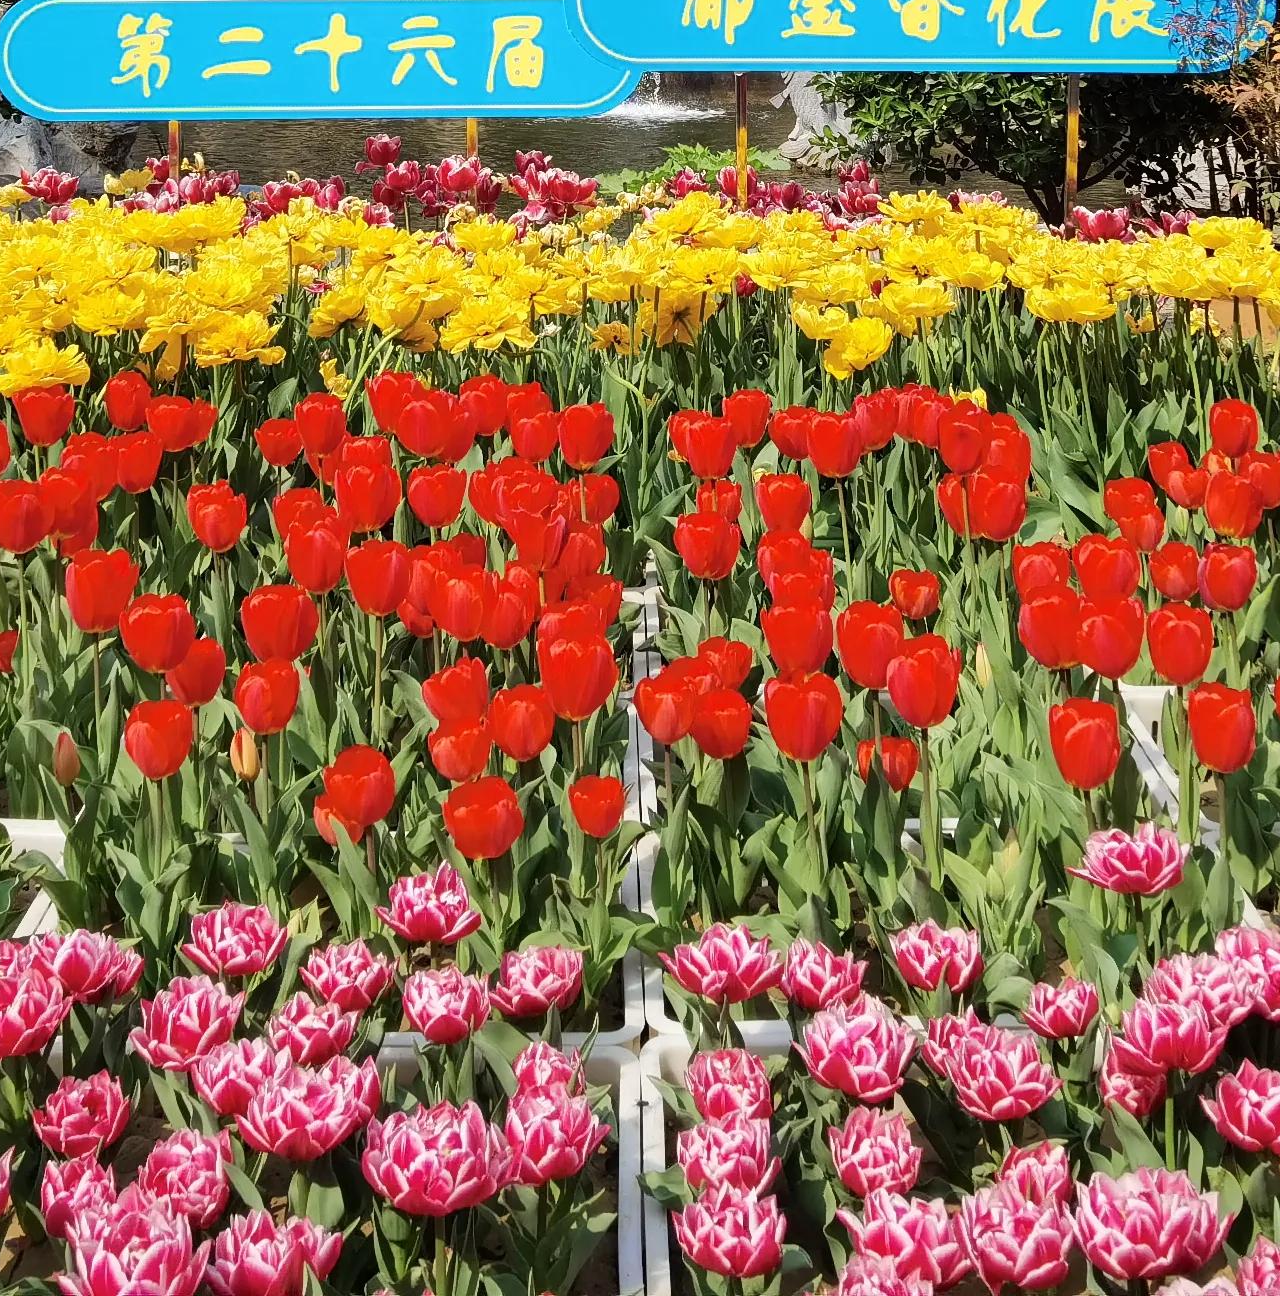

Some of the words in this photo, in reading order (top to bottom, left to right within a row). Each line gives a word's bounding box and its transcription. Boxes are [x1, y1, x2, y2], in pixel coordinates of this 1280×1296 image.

[110, 12, 546, 98] 第二十六届
